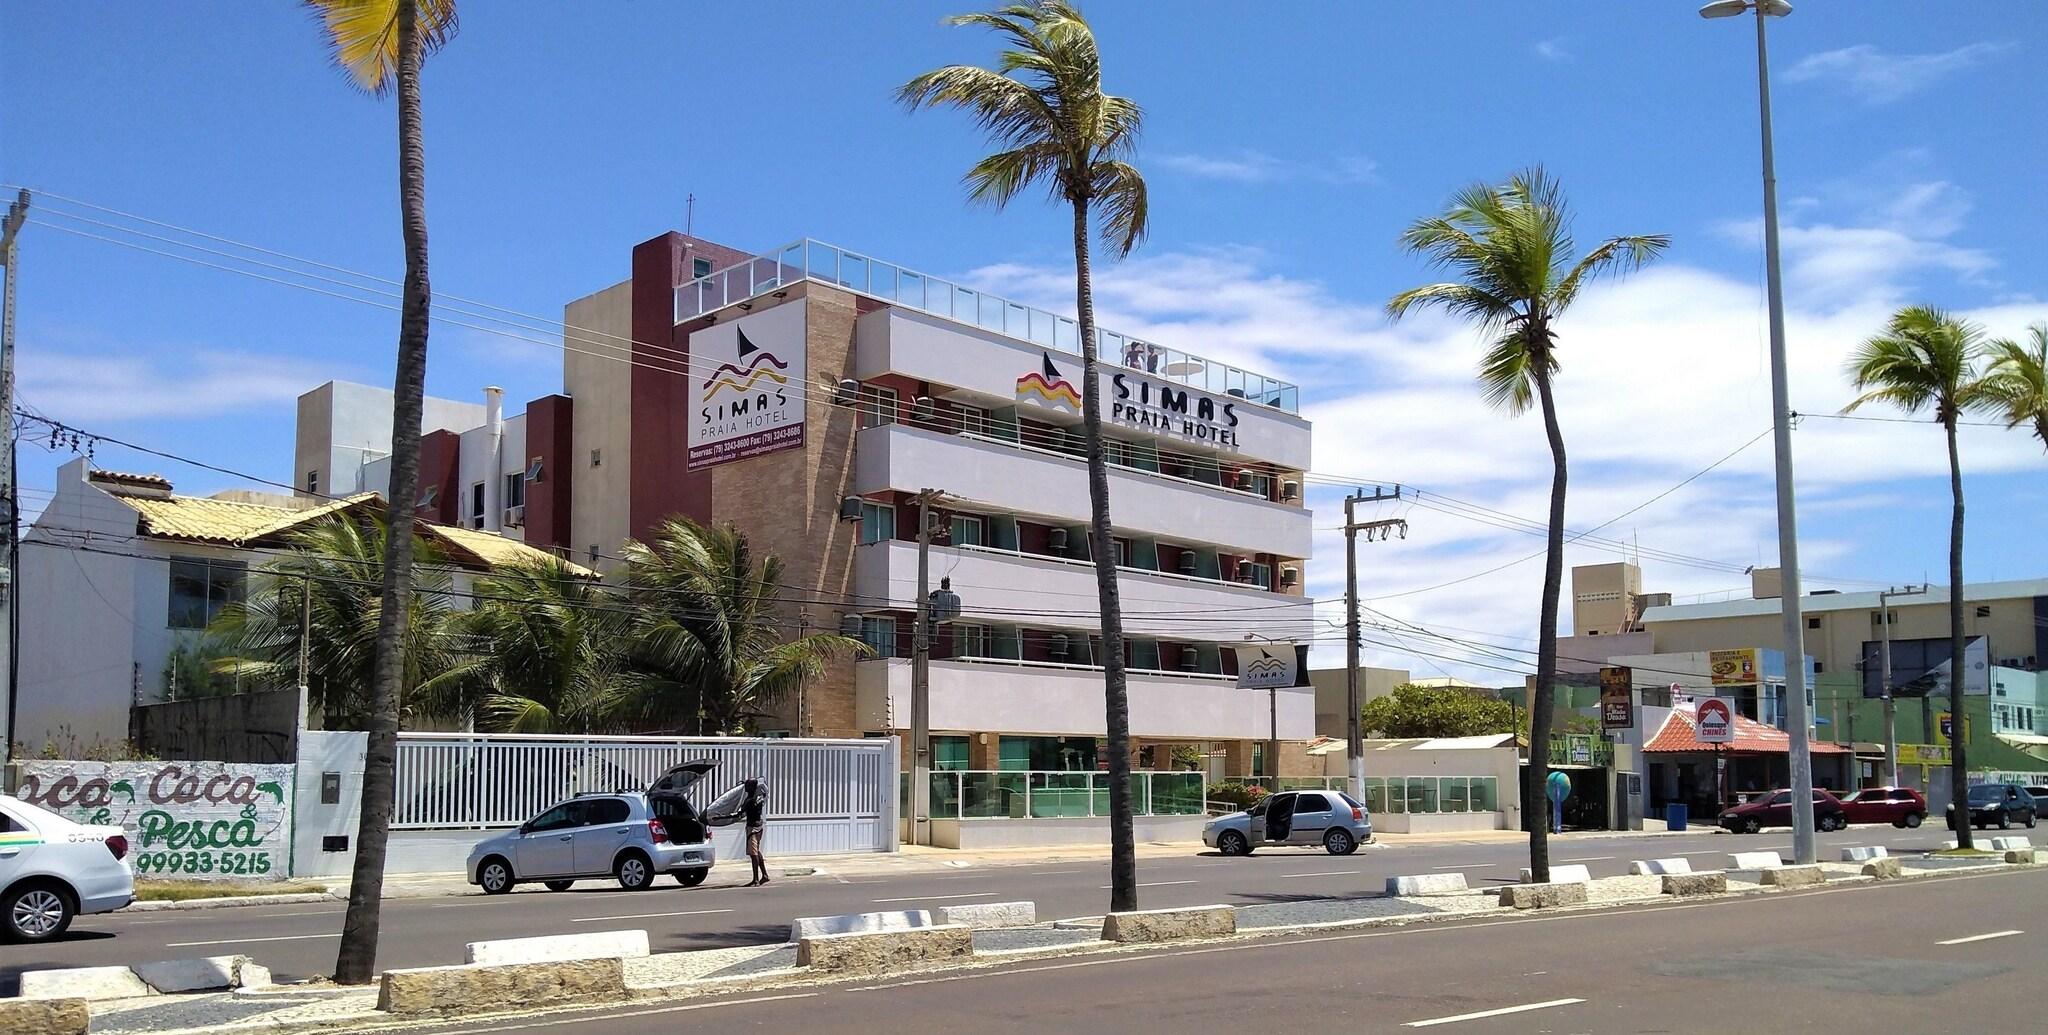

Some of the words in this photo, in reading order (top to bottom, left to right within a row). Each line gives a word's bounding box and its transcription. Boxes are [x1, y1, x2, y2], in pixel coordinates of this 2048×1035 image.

[701, 388, 787, 425] SIMAS
[1113, 373, 1239, 427] SIMAS
[701, 423, 738, 440] PRAIA
[746, 409, 789, 429] HOTEL
[1113, 402, 1171, 431] PRAIA
[1183, 420, 1241, 447] HOTEL
[690, 447, 713, 460] Reservas:
[750, 436, 762, 446] Fax:
[1247, 671, 1285, 680] SIMAS
[148, 765, 261, 808] Caça
[138, 809, 265, 851] Pesca
